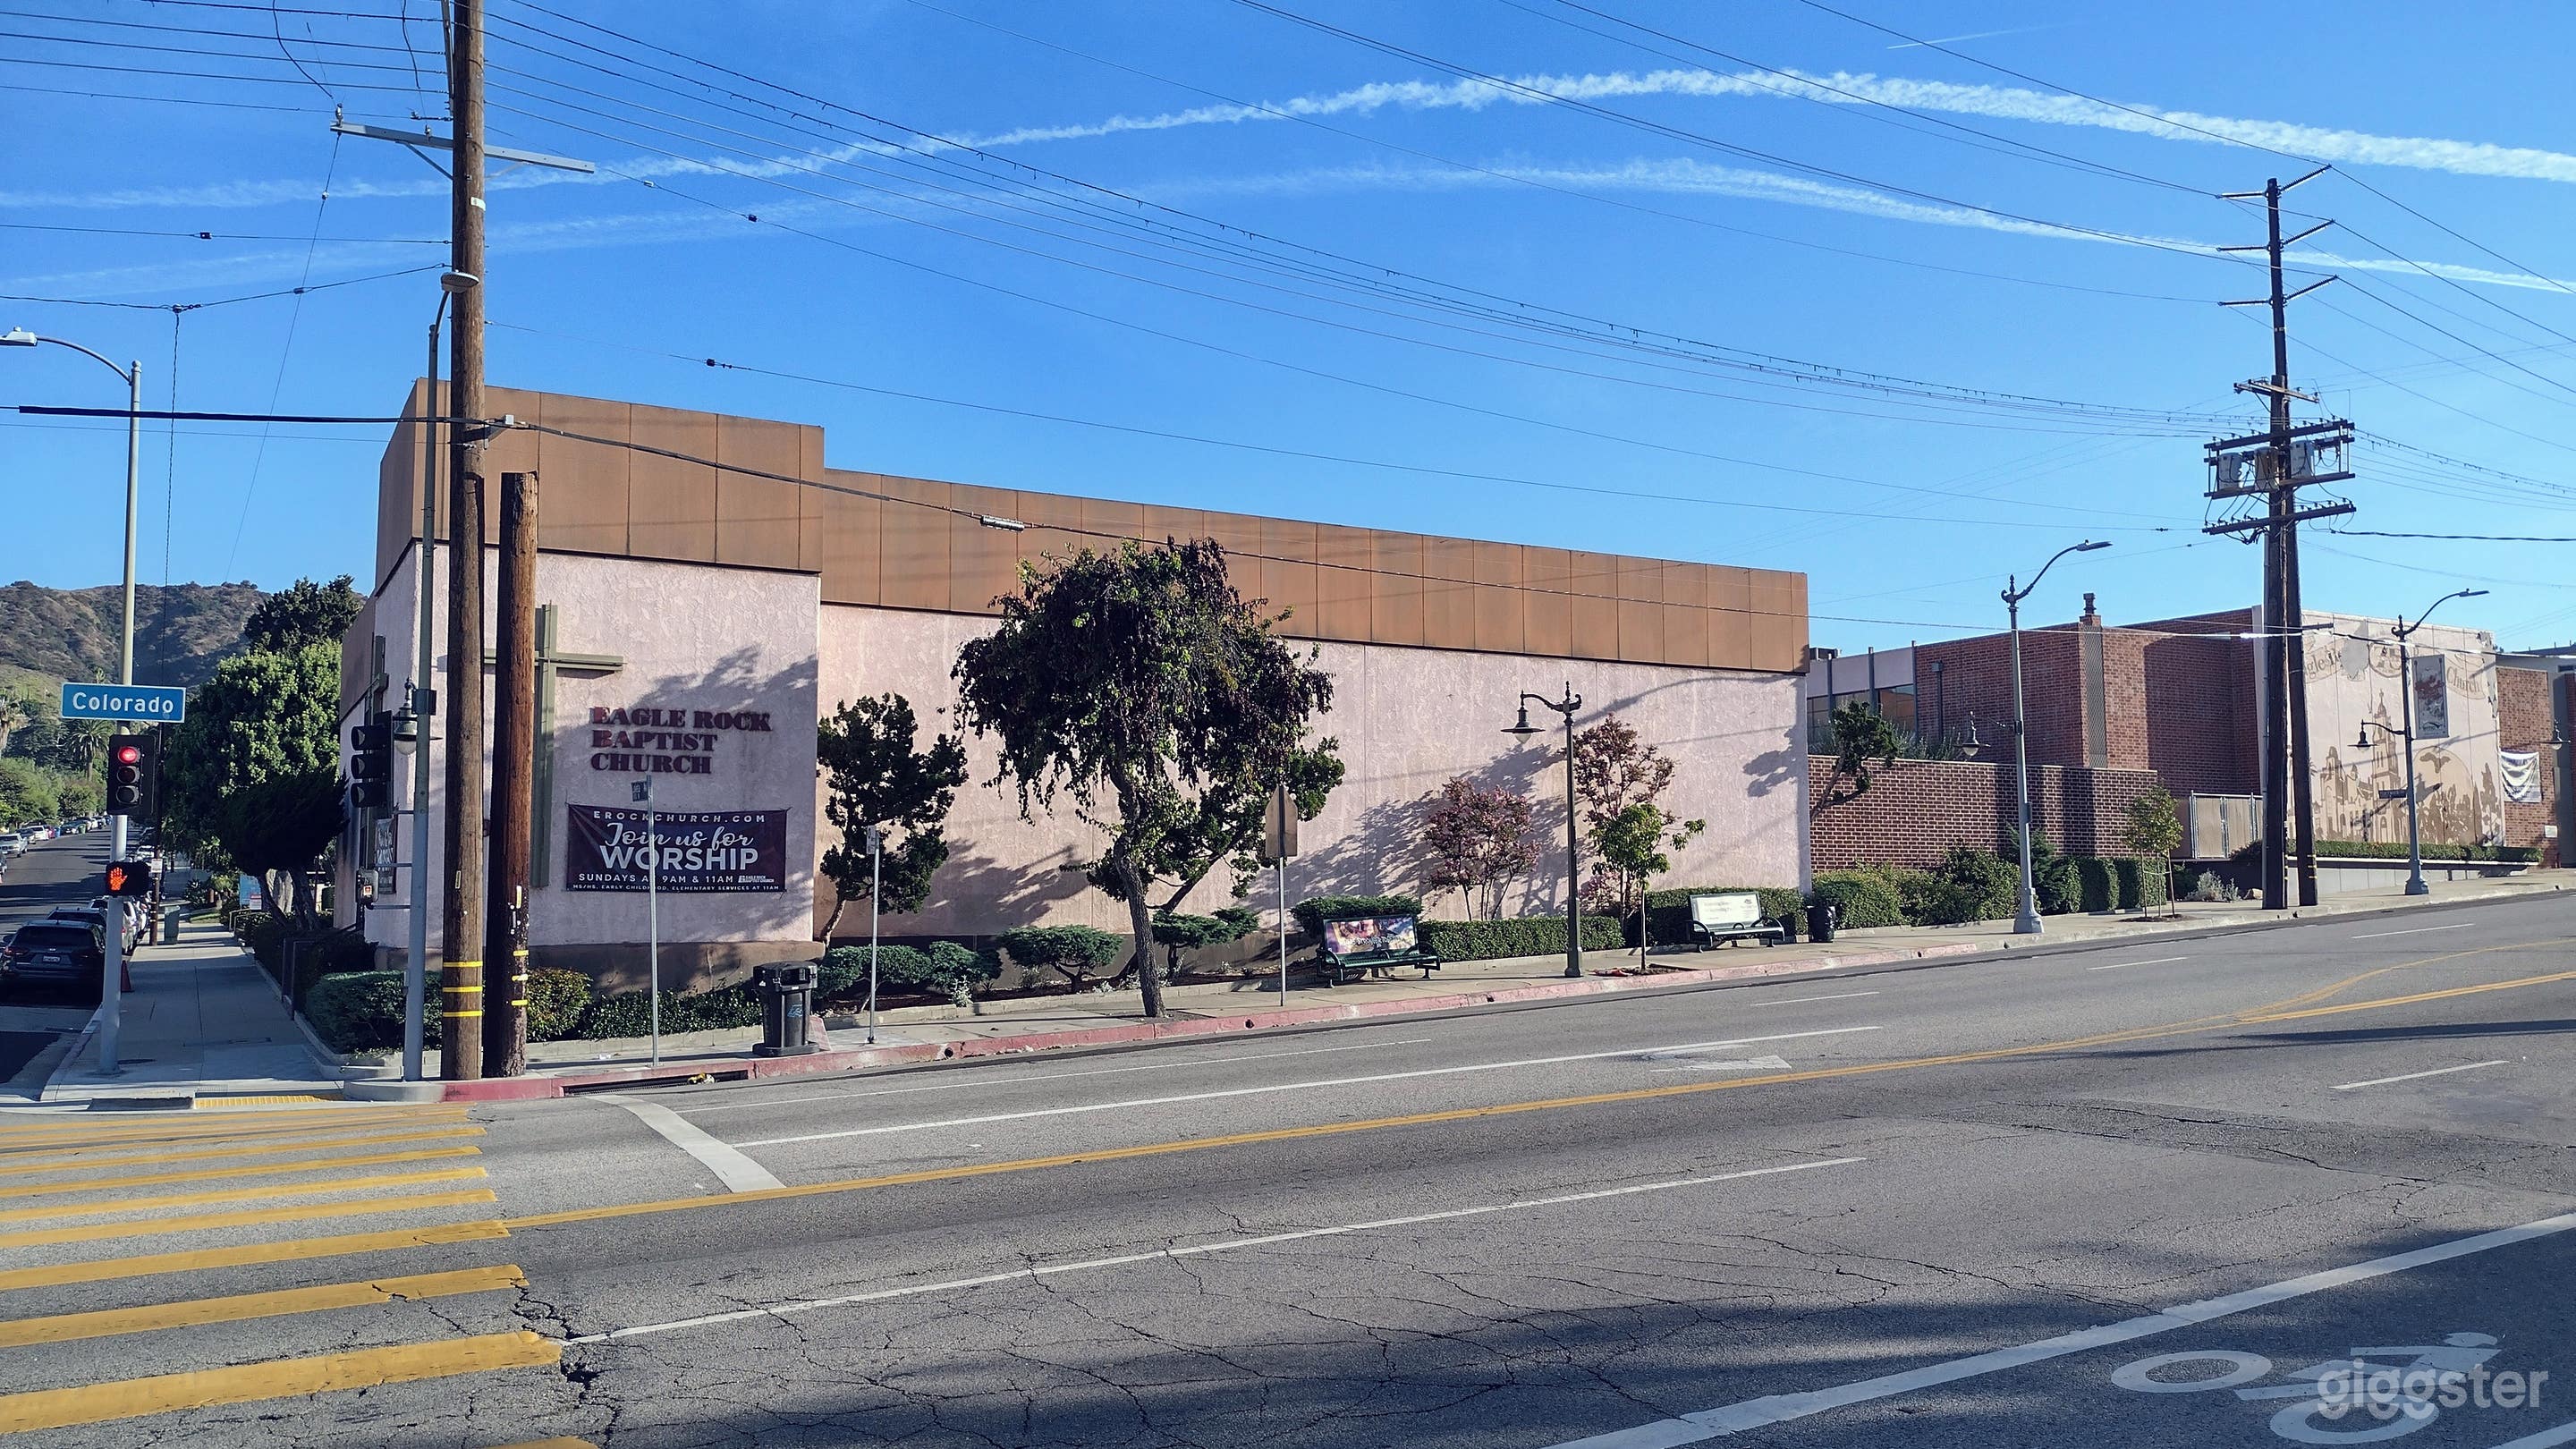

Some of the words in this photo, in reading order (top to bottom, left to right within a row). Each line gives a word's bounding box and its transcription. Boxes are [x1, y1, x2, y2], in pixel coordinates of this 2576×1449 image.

[2446, 665, 2480, 692] Church
[72, 691, 174, 714] Colorado
[589, 707, 686, 728] EAGLE
[692, 710, 772, 732] ROCK
[591, 730, 718, 752] BAPTIST
[590, 753, 712, 775] CHURCH
[603, 823, 672, 848] Join
[676, 832, 707, 847] us
[711, 826, 754, 852] for
[600, 845, 759, 870] WORSHIP
[579, 873, 636, 883] SUNDAYS
[662, 875, 686, 884] 9AM
[692, 875, 699, 884] &
[706, 875, 733, 884] 11AM
